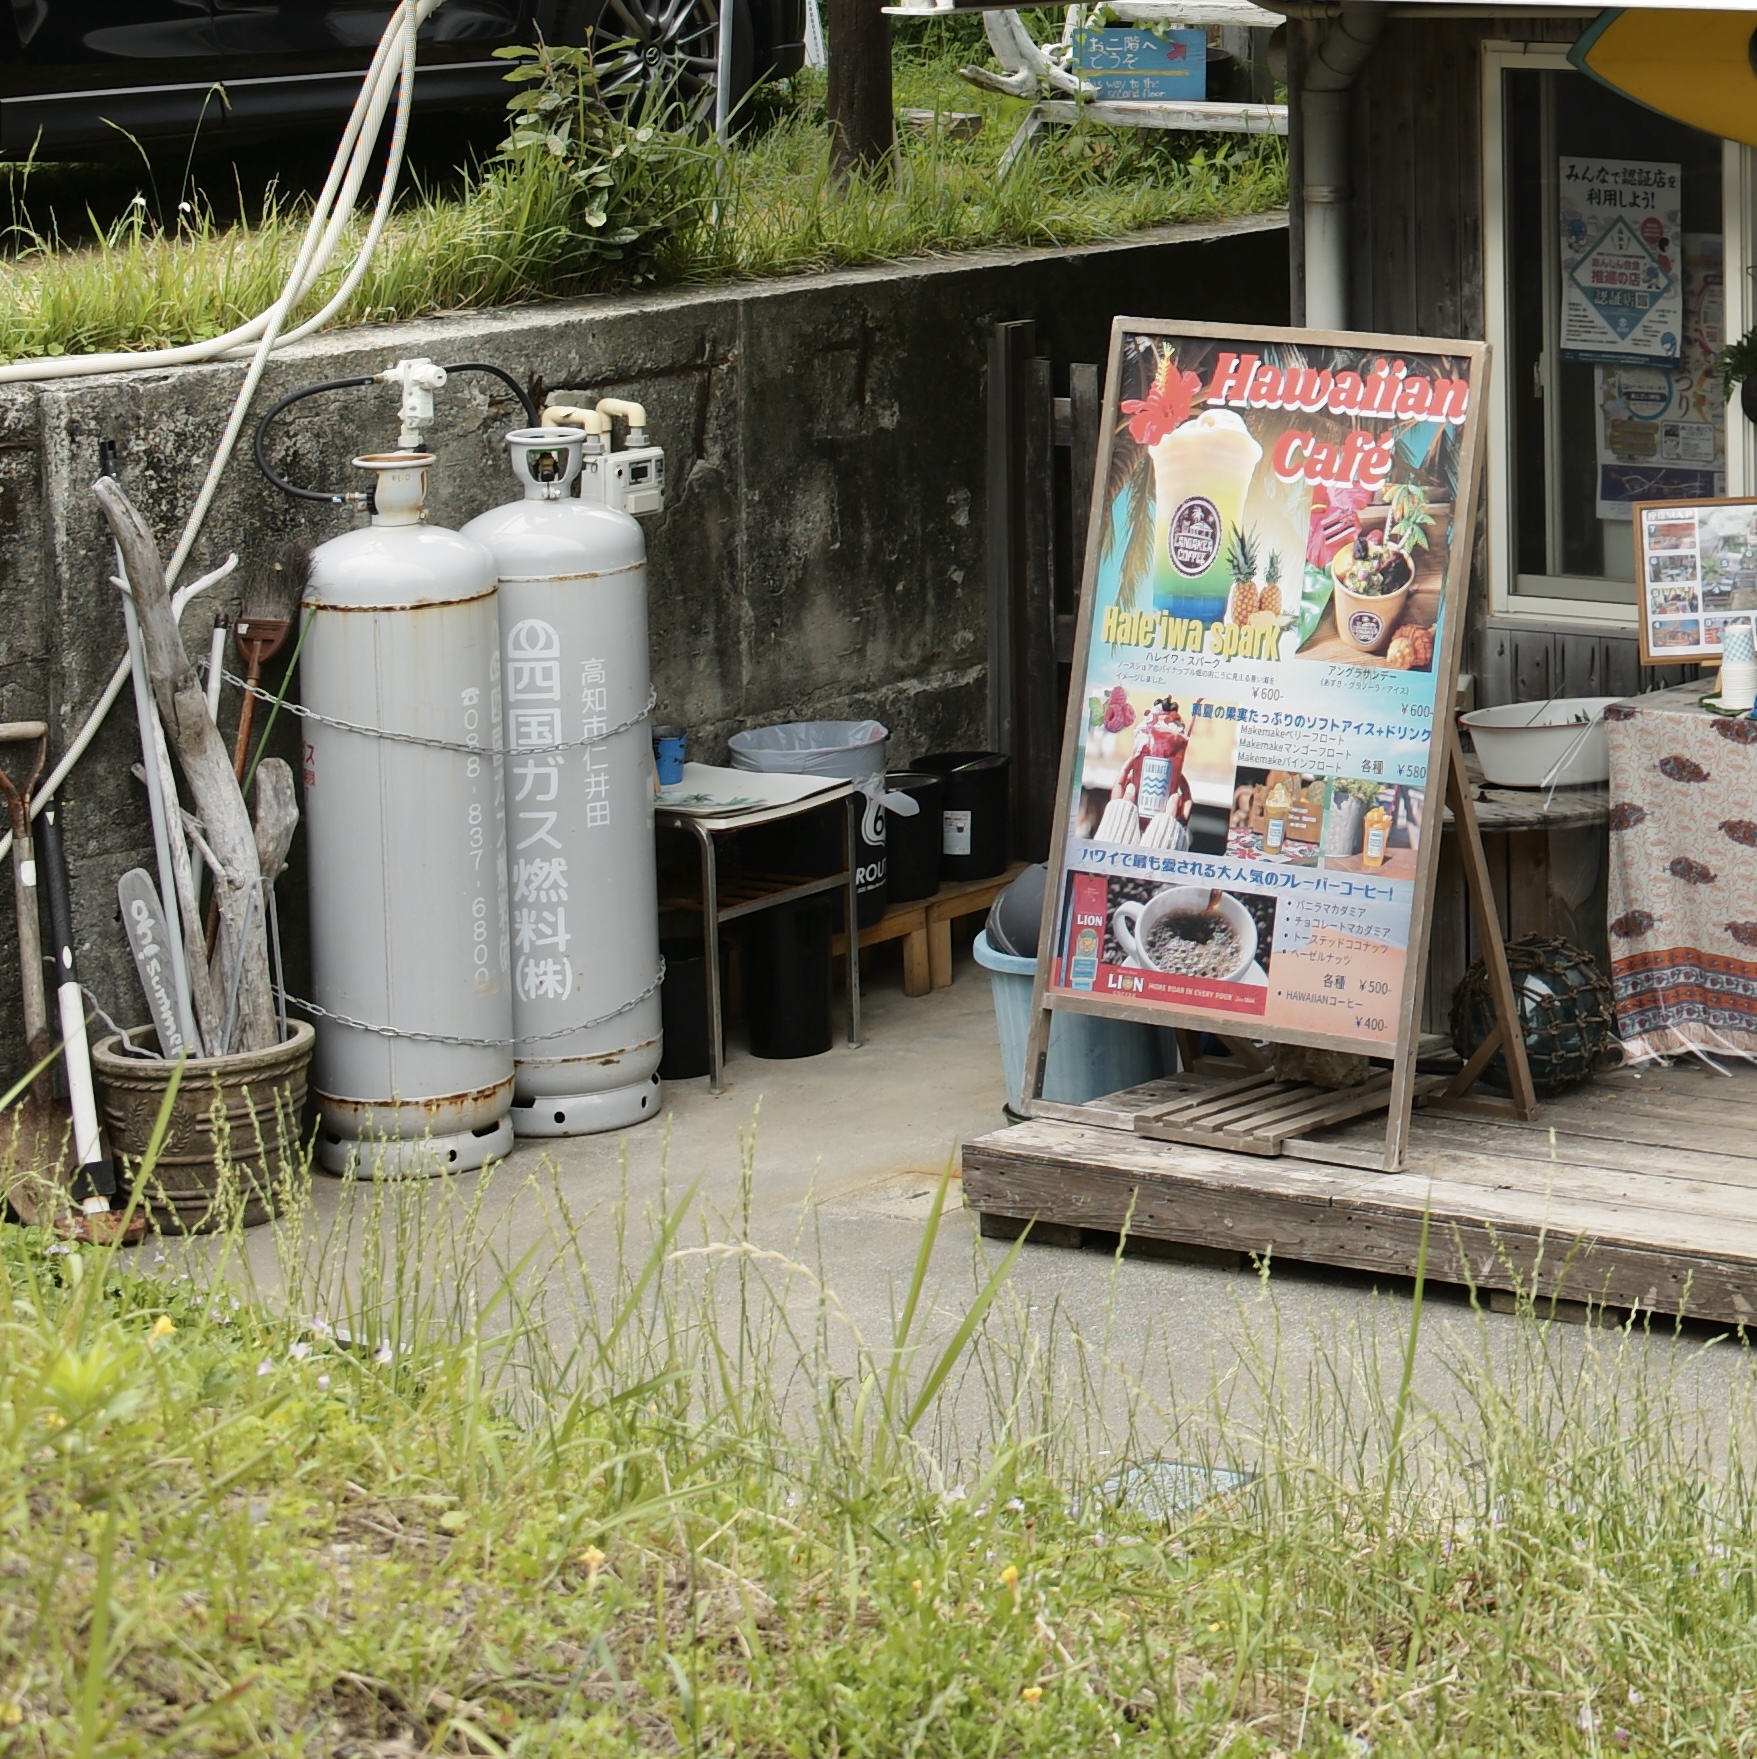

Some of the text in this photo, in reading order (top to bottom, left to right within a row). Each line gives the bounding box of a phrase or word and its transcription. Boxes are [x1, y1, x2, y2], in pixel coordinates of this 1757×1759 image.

[1088, 36, 1158, 55] お二階へ
[1565, 164, 1677, 189] みんなで認証店を
[1206, 351, 1469, 425] Hawaiian
[1272, 429, 1395, 490] Café
[1208, 621, 1282, 663] spark
[580, 657, 610, 828] 高知市仁井田
[1240, 724, 1345, 744] Makemakeベリーフロート
[1239, 737, 1352, 760] Makemakeマンゴーフロート
[1361, 759, 1384, 775] 各種
[1296, 900, 1367, 918] バニラマカダミア
[1077, 914, 1103, 927] LION
[1294, 916, 1392, 938] チョコレートマカダミア
[1294, 932, 1390, 954] トーステッドココナッツ
[1290, 949, 1352, 966] ヘーゼルナッツ
[1322, 973, 1346, 990] 各種
[1286, 990, 1364, 1009] HAWAIIANコーヒー
